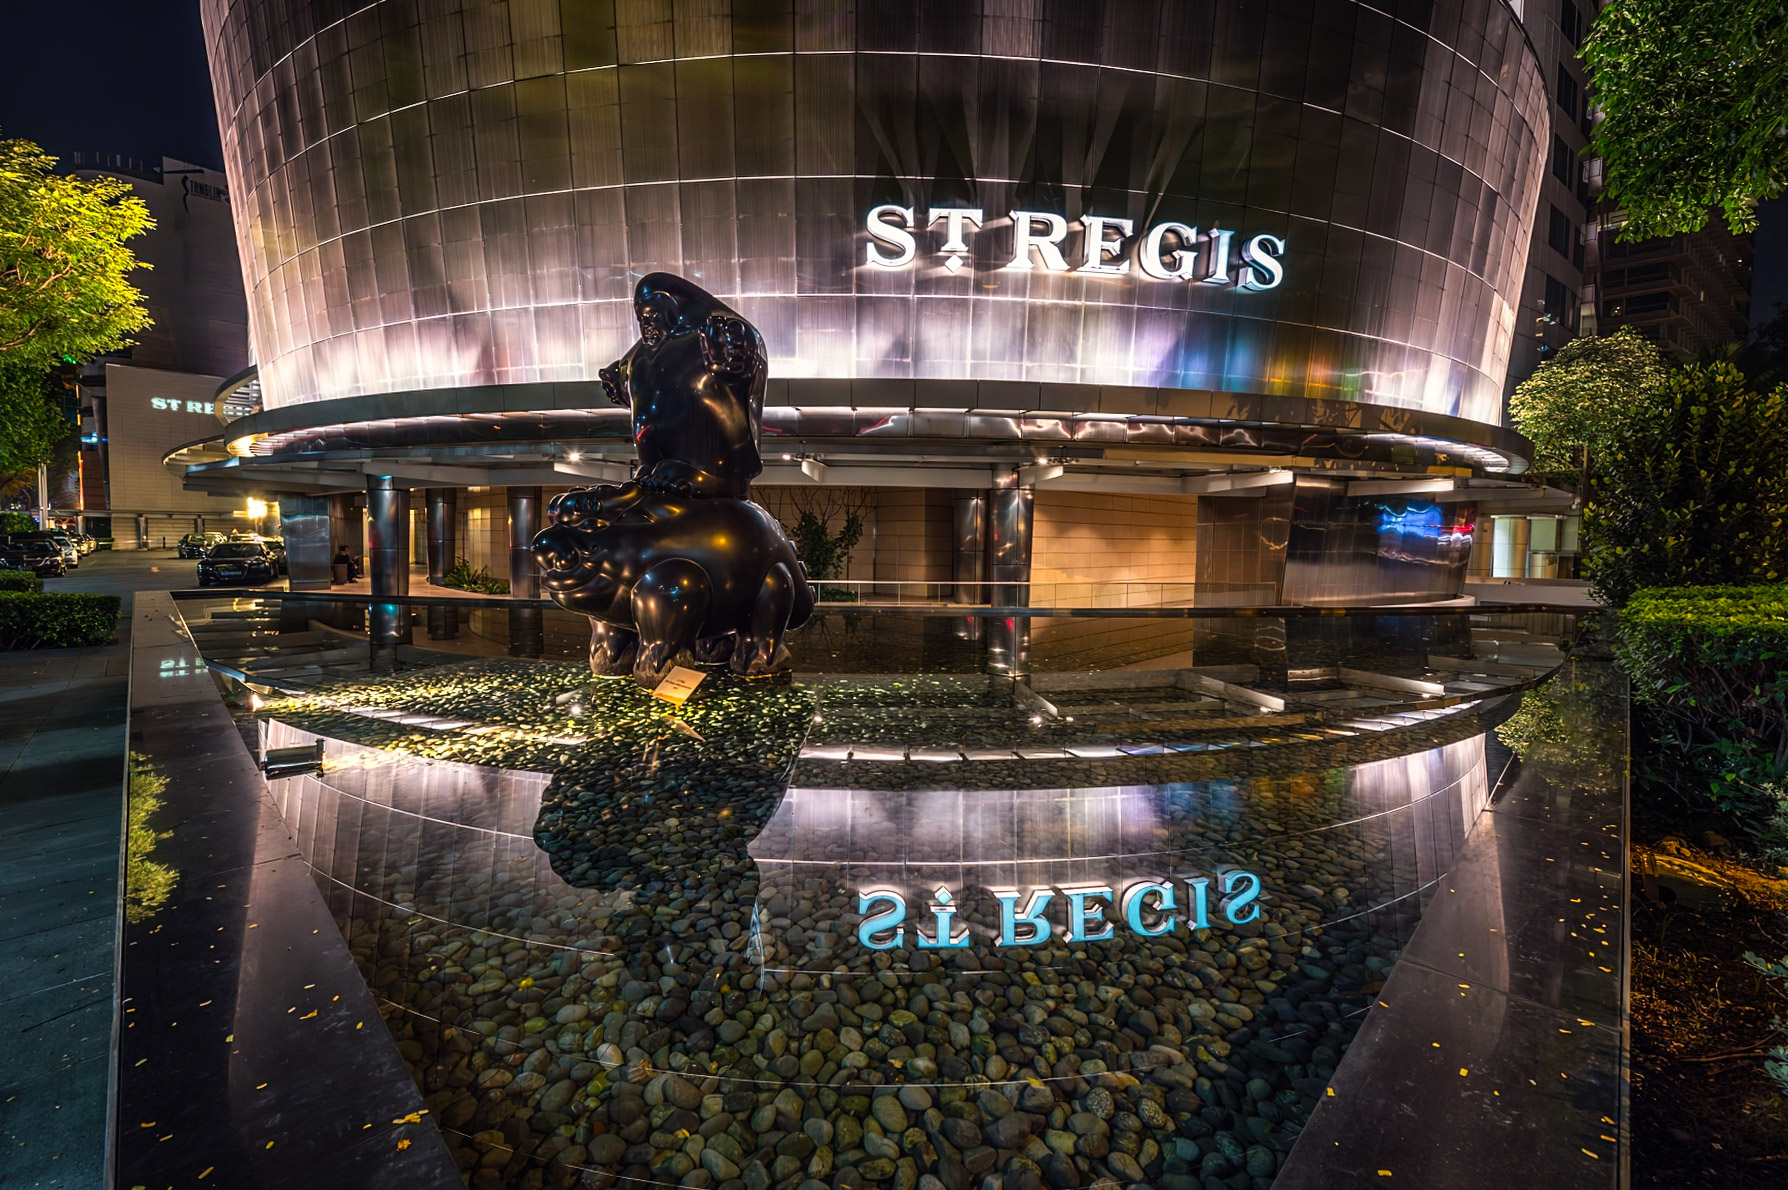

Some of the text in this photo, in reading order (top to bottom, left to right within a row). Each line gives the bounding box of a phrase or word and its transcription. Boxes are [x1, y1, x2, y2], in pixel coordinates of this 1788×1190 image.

[1006, 210, 1286, 292] REGIS
[151, 397, 215, 414] ST RE
